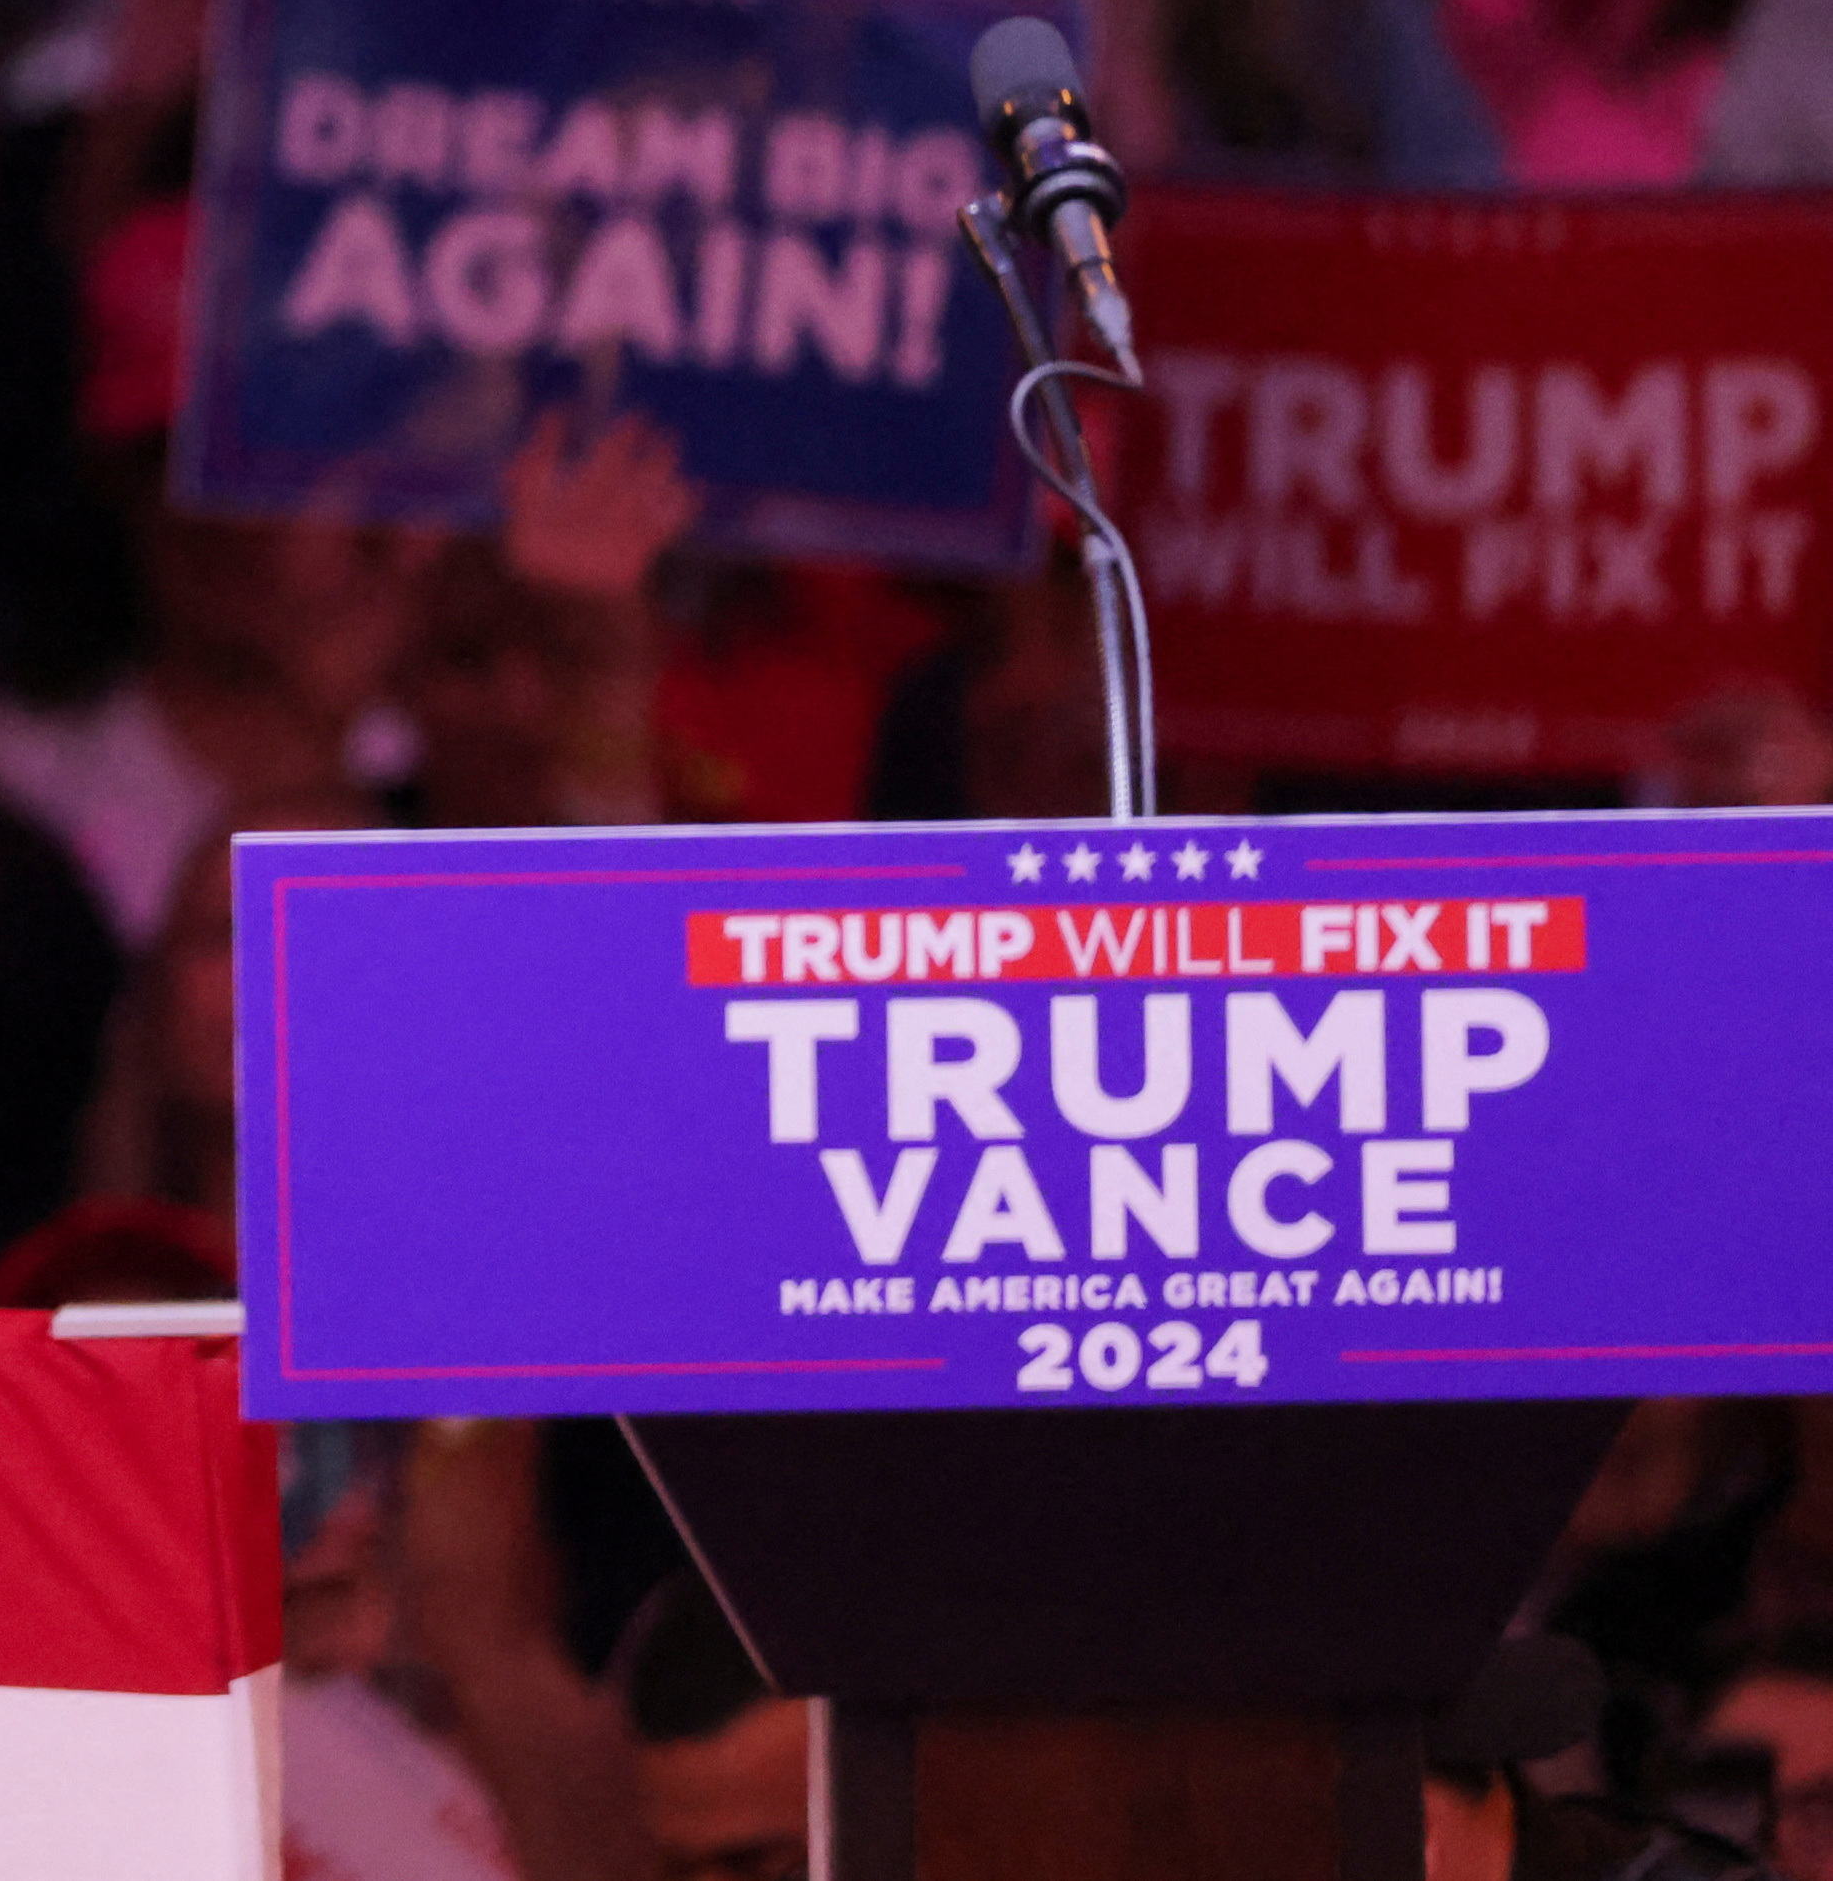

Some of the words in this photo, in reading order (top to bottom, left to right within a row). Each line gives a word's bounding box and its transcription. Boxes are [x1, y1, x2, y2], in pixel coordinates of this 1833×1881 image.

[276, 71, 738, 207] DREAM
[275, 189, 958, 394] AGAIN!
[1138, 347, 1818, 517] TRUMP
[1458, 517, 1671, 621] FIX
[723, 911, 1035, 983] TRUMP
[1055, 906, 1274, 977] WILL
[1300, 903, 1443, 973] FIX
[1466, 900, 1549, 971] IT
[724, 987, 1551, 1144] TRUMP
[818, 1138, 1457, 1265] VANCE
[779, 1276, 916, 1315] MAKE
[927, 1273, 1148, 1312] AMERICA
[1162, 1270, 1319, 1309] GREAT
[1334, 1266, 1504, 1307] AGAIN!
[1016, 1319, 1268, 1392] 2024
